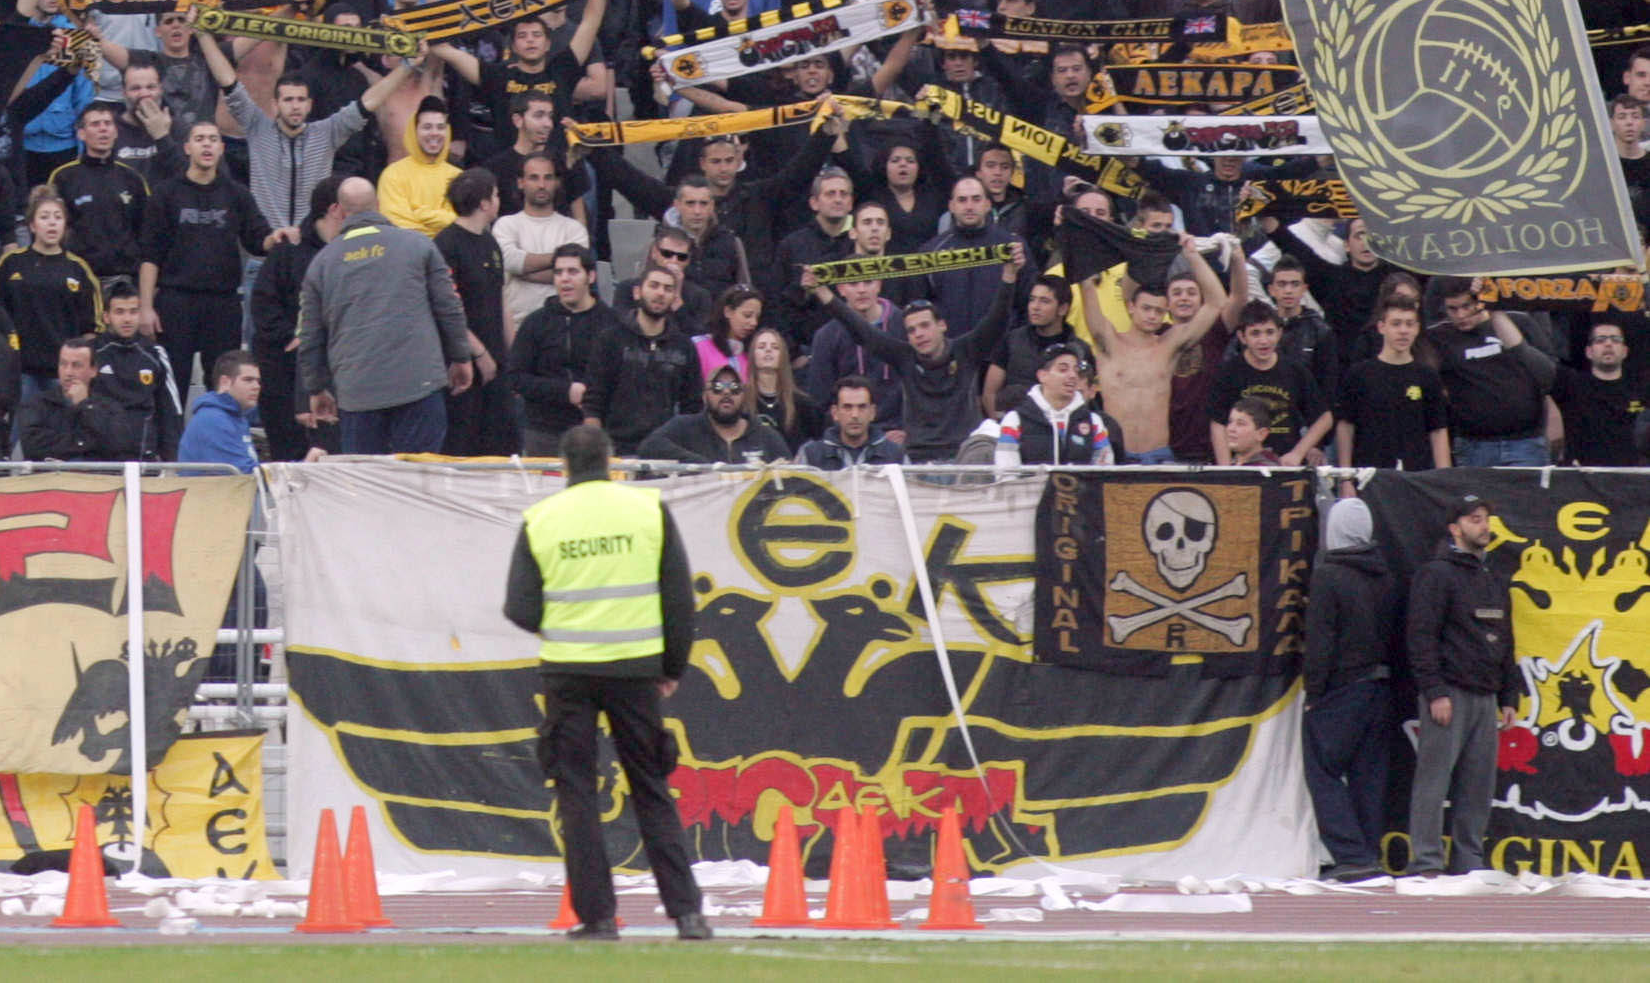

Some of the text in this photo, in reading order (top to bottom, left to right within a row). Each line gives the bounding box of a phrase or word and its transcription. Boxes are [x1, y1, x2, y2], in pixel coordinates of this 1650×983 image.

[231, 17, 380, 49] AEK ORIGINAL
[1004, 17, 1171, 37] LONDON CLUB
[1133, 70, 1275, 98] ΑΕΚΑΡΑ
[558, 533, 636, 561] SECURITY
[1052, 473, 1080, 654] ORIGINAL
[206, 751, 259, 880] AE
